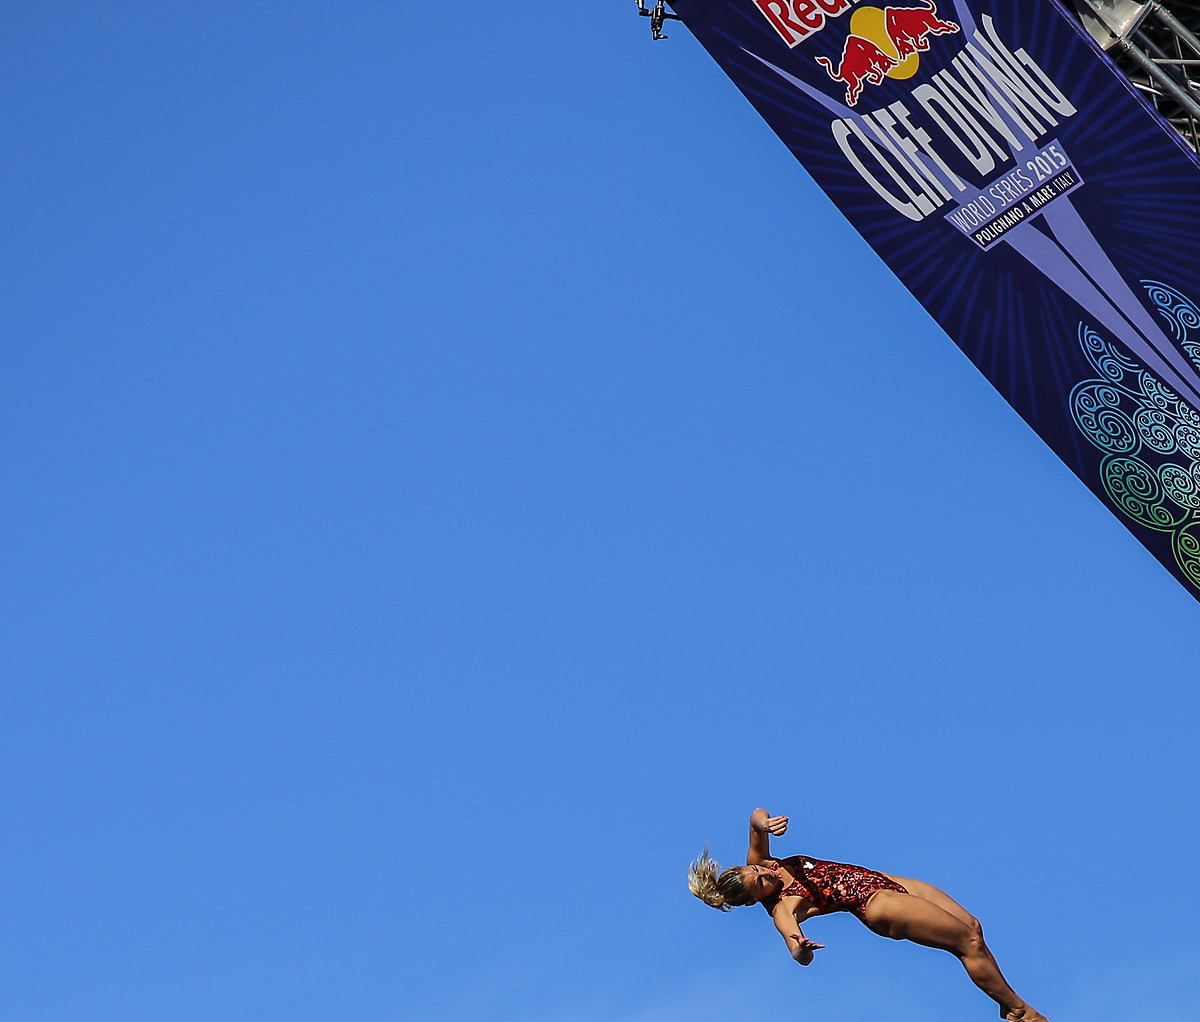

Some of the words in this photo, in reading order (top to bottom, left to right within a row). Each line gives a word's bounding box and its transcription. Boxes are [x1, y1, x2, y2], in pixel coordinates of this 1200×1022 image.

[753, 0, 851, 48] Re
[831, 101, 966, 221] CLIFF
[911, 13, 1077, 176] DIVING
[950, 195, 996, 233] WORLD
[989, 168, 1034, 207] SERIES
[1026, 145, 1067, 181] 2015
[975, 207, 1024, 246] POLIGNANO
[1021, 201, 1033, 213] A
[1029, 185, 1056, 208] MARE
[1052, 172, 1075, 192] ITALY
